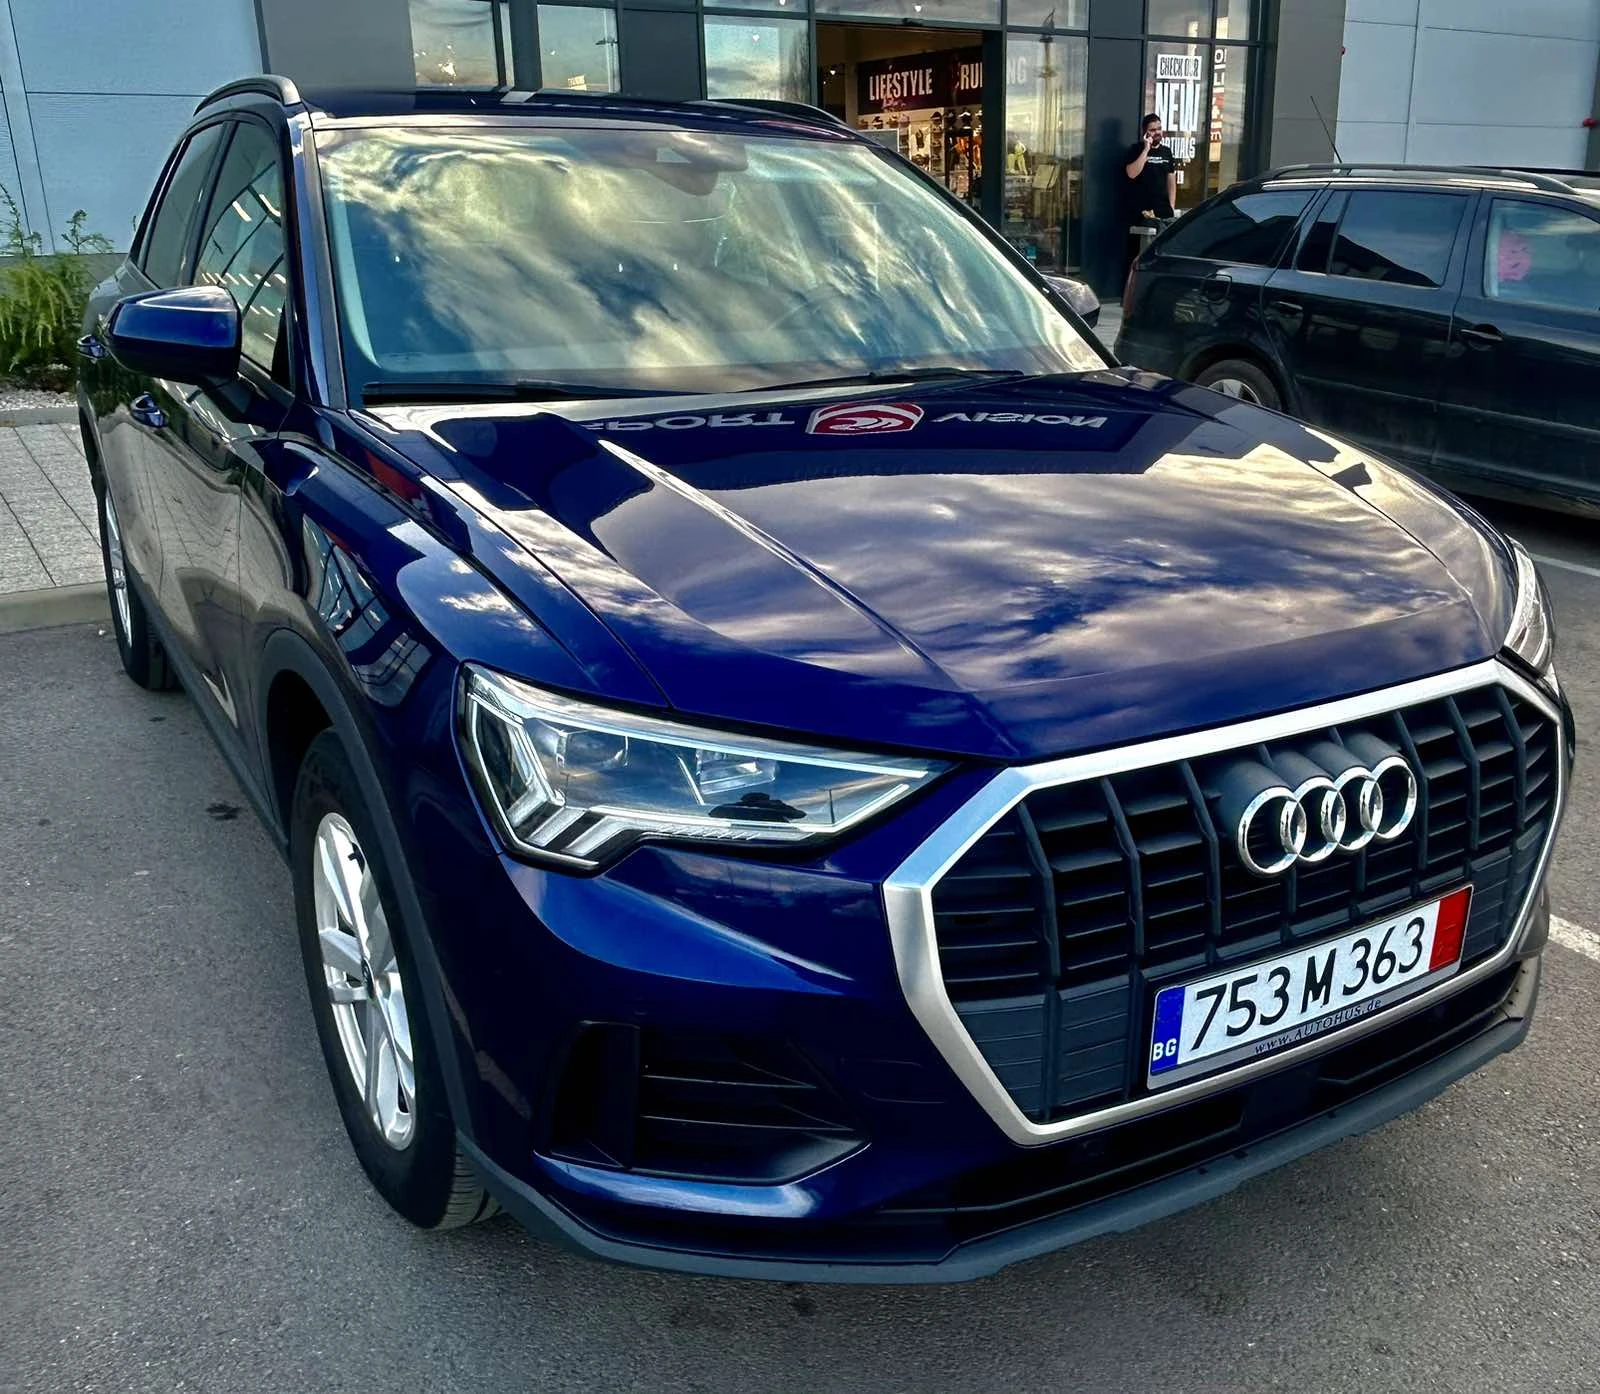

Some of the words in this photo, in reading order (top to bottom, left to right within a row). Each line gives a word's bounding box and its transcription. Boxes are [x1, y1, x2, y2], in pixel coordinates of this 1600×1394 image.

[868, 67, 934, 101] LIFESTYLE
[1159, 56, 1184, 77] CHECK
[1184, 57, 1199, 78] OR
[1155, 82, 1201, 132] NEW
[1190, 966, 1290, 1051] 753
[1301, 948, 1337, 1014] M
[1342, 916, 1426, 996] 363
[1254, 998, 1382, 1054] www.AUTOHUS.de
[1152, 1037, 1177, 1062] BG
